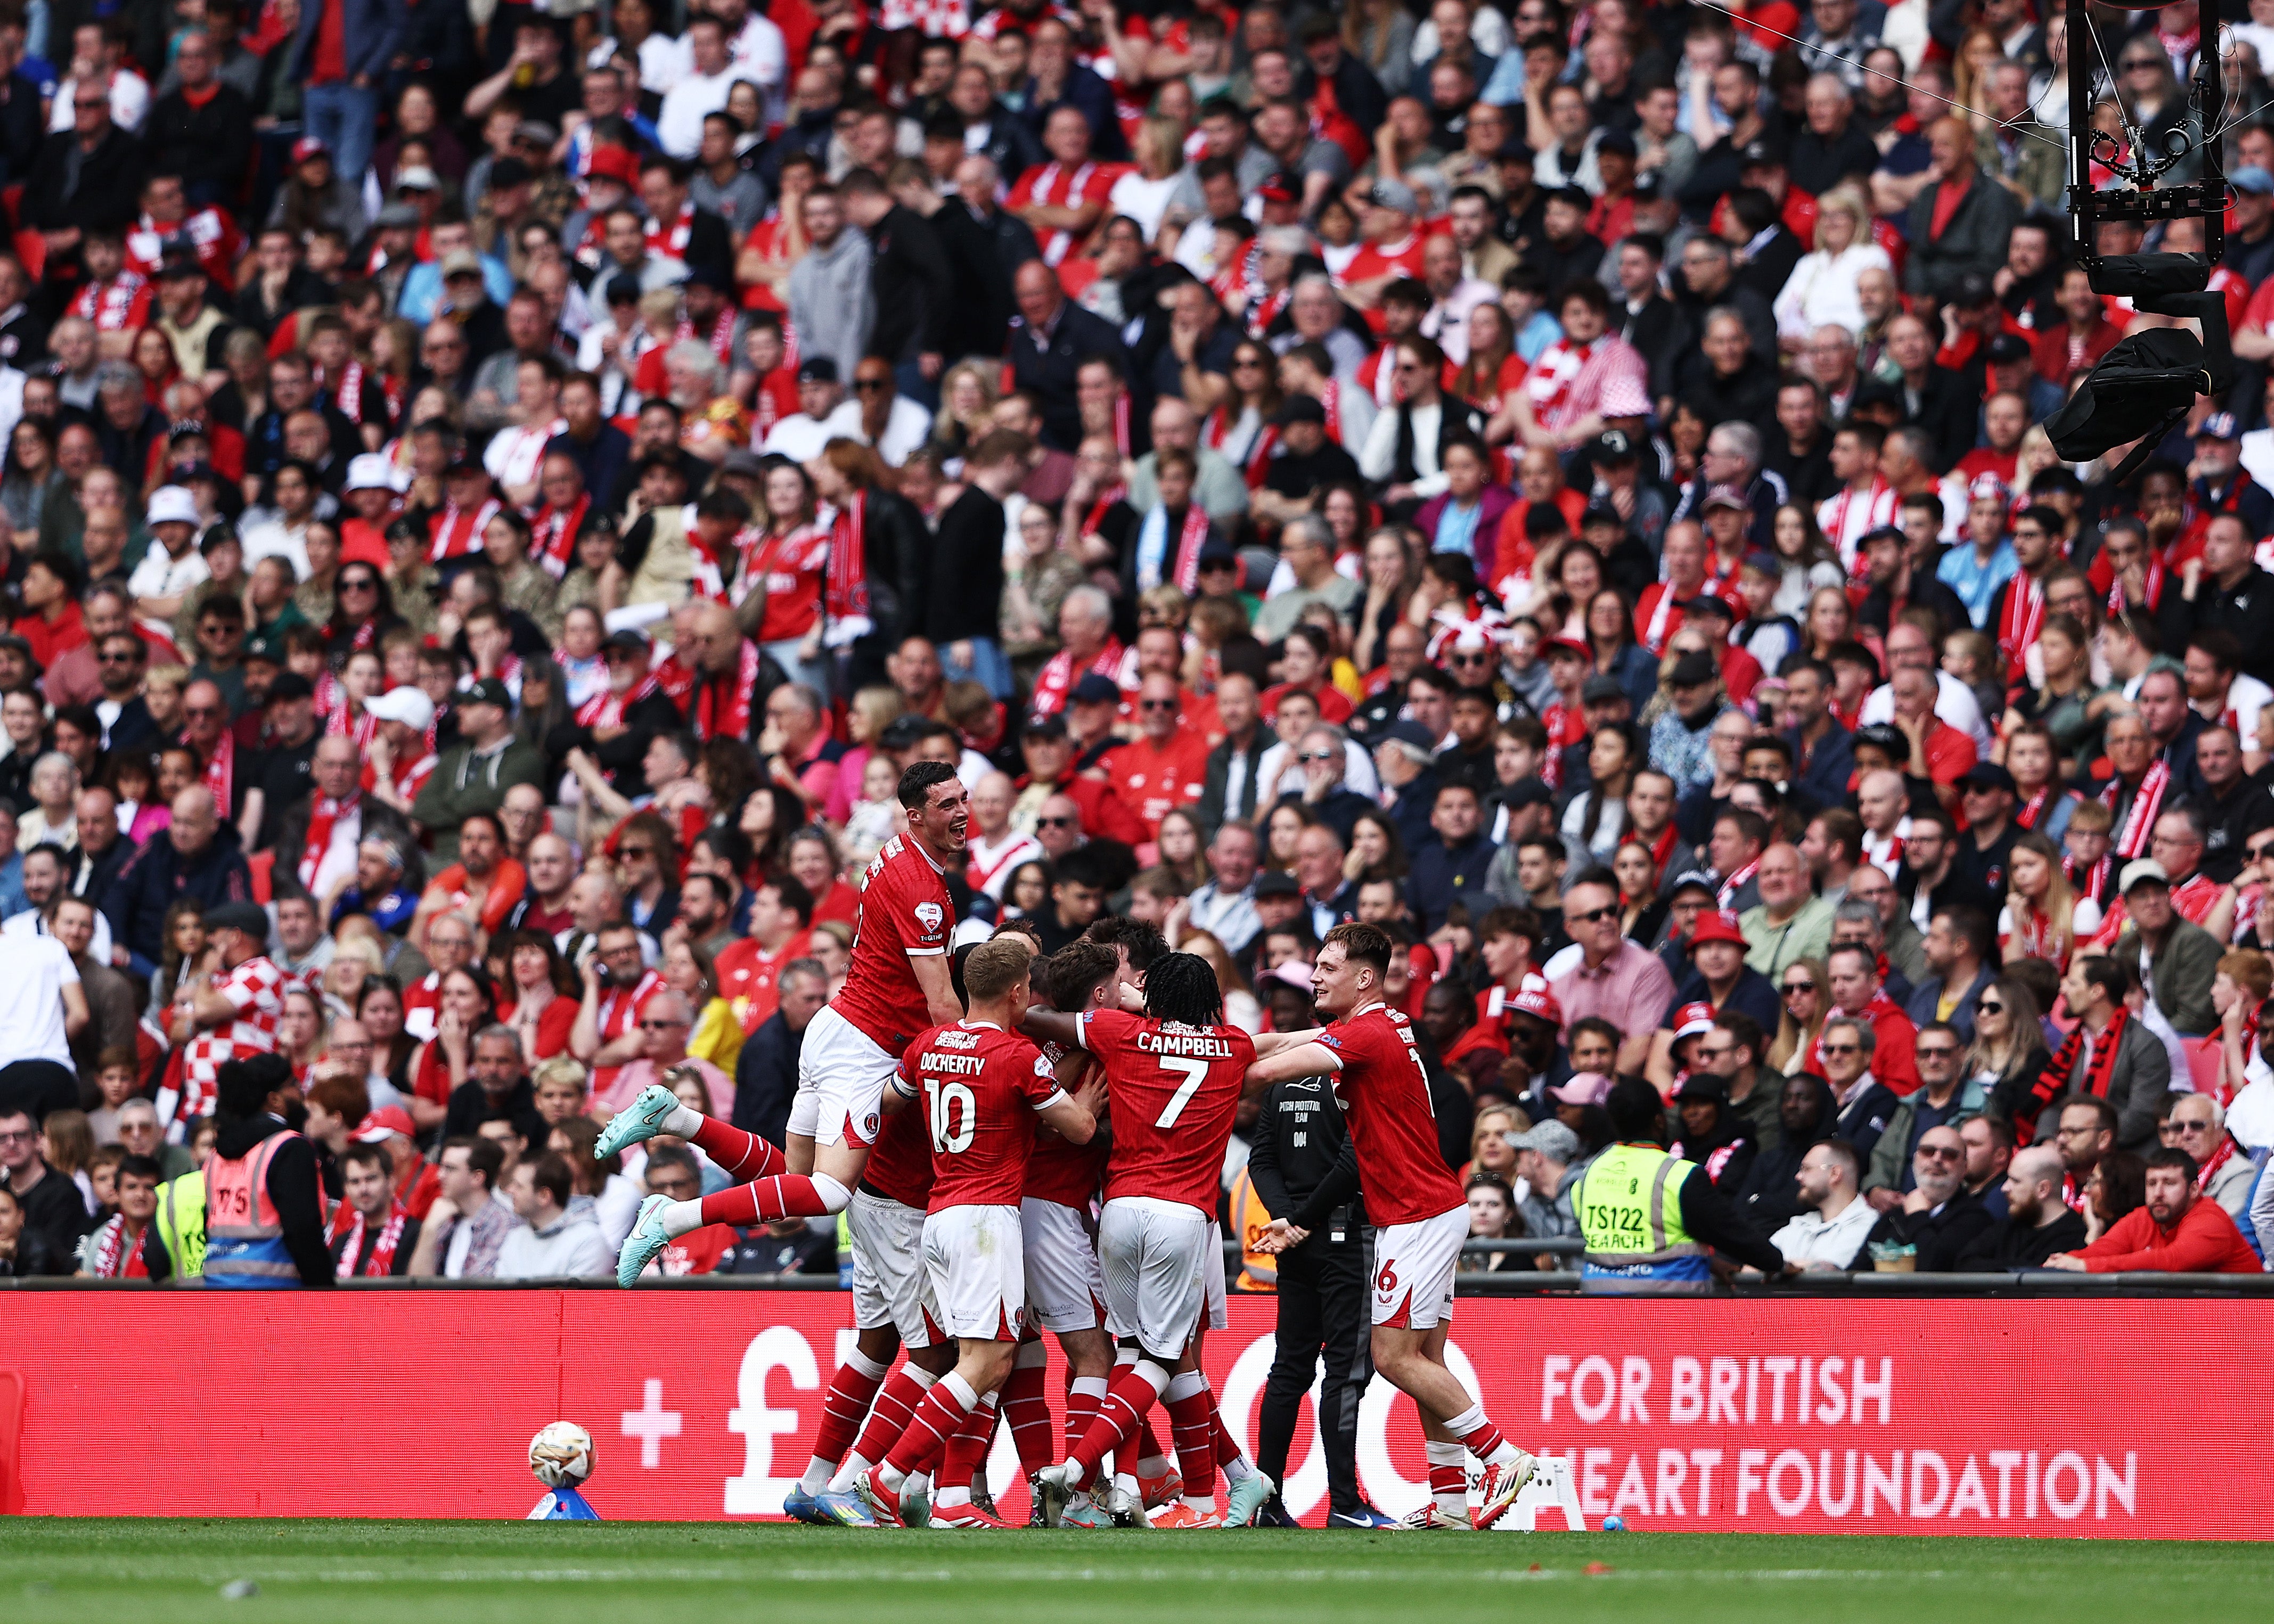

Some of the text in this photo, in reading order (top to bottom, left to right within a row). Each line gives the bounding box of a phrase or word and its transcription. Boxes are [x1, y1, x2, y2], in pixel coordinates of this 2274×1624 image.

[920, 1052, 985, 1076] DOCHERTY
[1138, 1031, 1233, 1057] CAMPBELL
[923, 1078, 976, 1153] 10
[1155, 1055, 1209, 1128] 7
[1295, 1112, 1308, 1123] TEAM
[1588, 1205, 1644, 1232] TS122
[1541, 1356, 1894, 1426] FOR BRITISH
[1536, 1447, 2138, 1521] EART FOUNDATION
